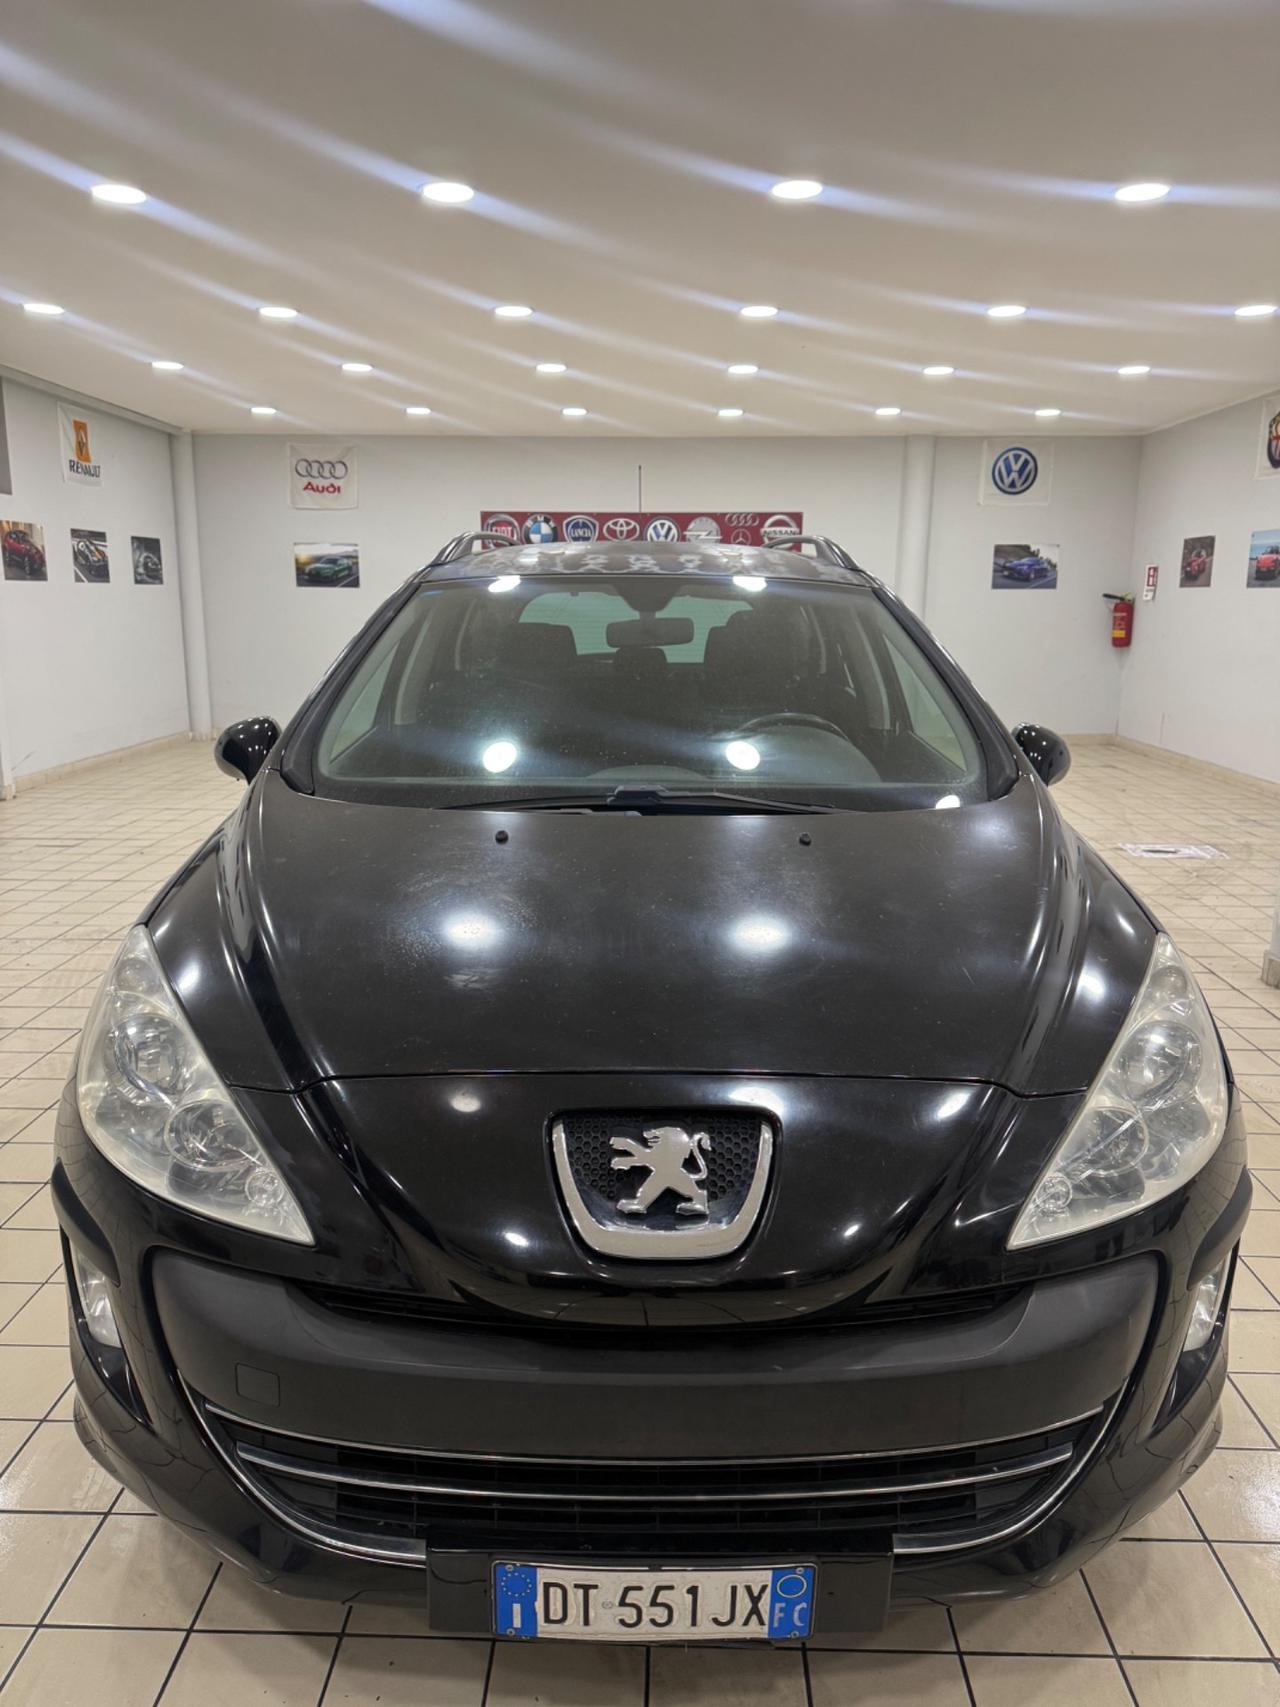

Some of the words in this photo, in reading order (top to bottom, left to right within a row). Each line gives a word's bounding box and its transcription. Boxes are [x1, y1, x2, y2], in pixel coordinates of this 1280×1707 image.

[69, 459, 101, 478] RENAULT
[303, 481, 341, 494] Audi
[570, 527, 592, 538] LANCIA
[762, 529, 800, 538] NISSAN
[541, 1581, 599, 1626] DT
[618, 1585, 701, 1629] 551
[711, 1583, 769, 1627] JX
